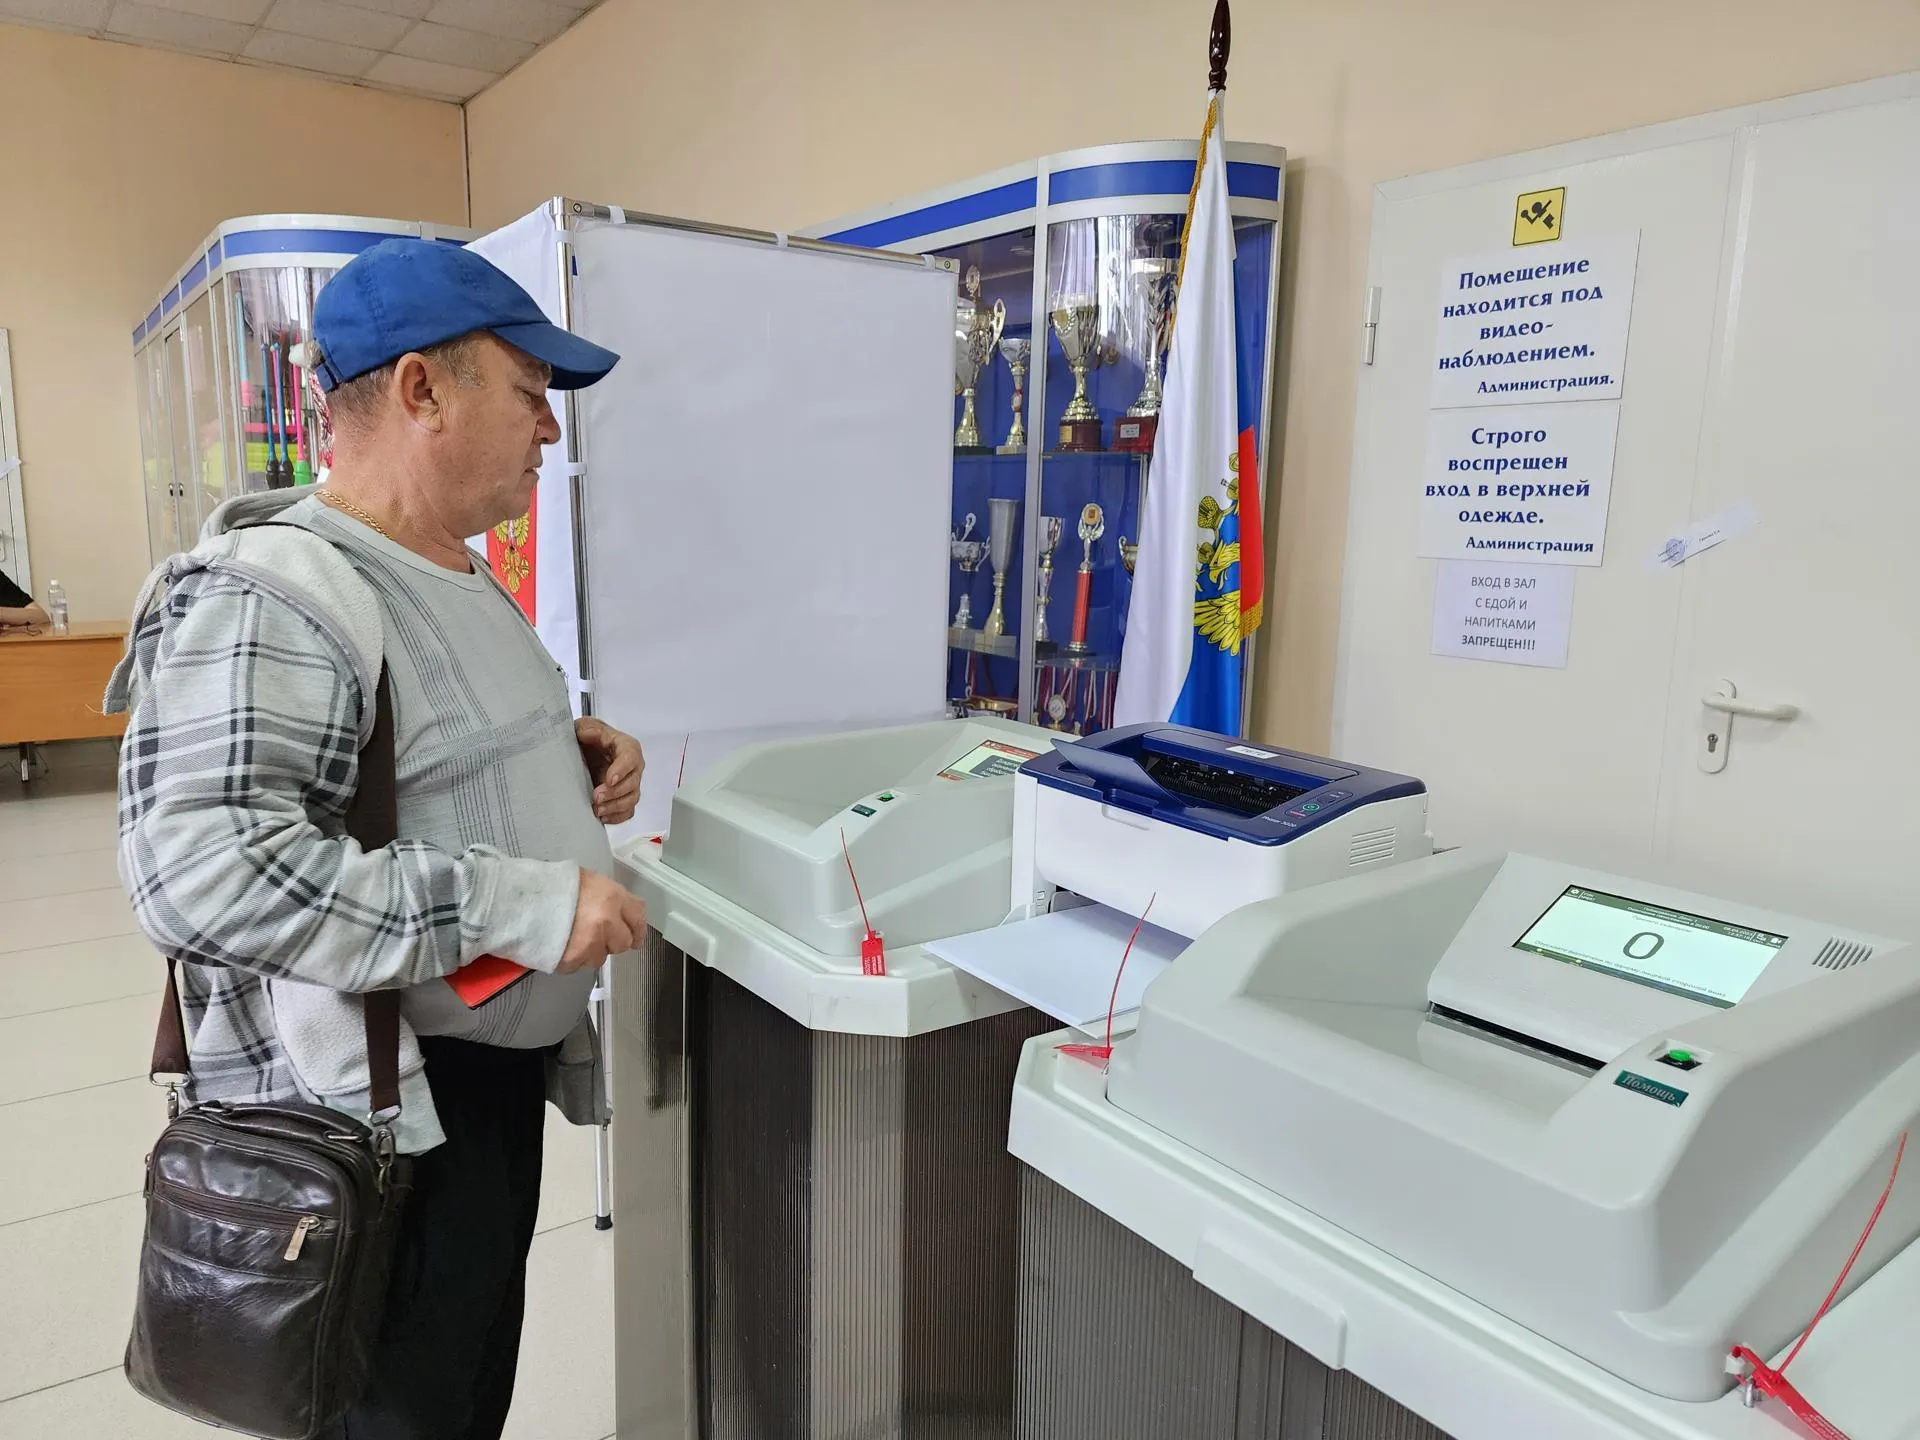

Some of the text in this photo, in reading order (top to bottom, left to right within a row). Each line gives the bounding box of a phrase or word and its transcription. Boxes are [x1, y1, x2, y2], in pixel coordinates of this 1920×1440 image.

[1459, 259, 1590, 290] Помещение
[1443, 286, 1603, 319] находится под
[1479, 321, 1554, 341] видео-
[1438, 343, 1595, 370] наблюдением.
[1477, 375, 1615, 394] Администрация.
[1471, 427, 1547, 449] Строго
[1448, 456, 1568, 476] воспрещен
[1425, 479, 1590, 502] вход в верхней
[1458, 509, 1544, 524] одежде.
[1465, 536, 1594, 555] Администрация
[1471, 576, 1536, 590] ВХОД В ЗАЛ
[1475, 596, 1528, 611] С ЕДОЙ И
[1464, 615, 1536, 631] НАПИТКАМИ
[1461, 634, 1536, 651] ЗАПРЕЩЕН!!!
[1622, 1074, 1676, 1100] Помощь
